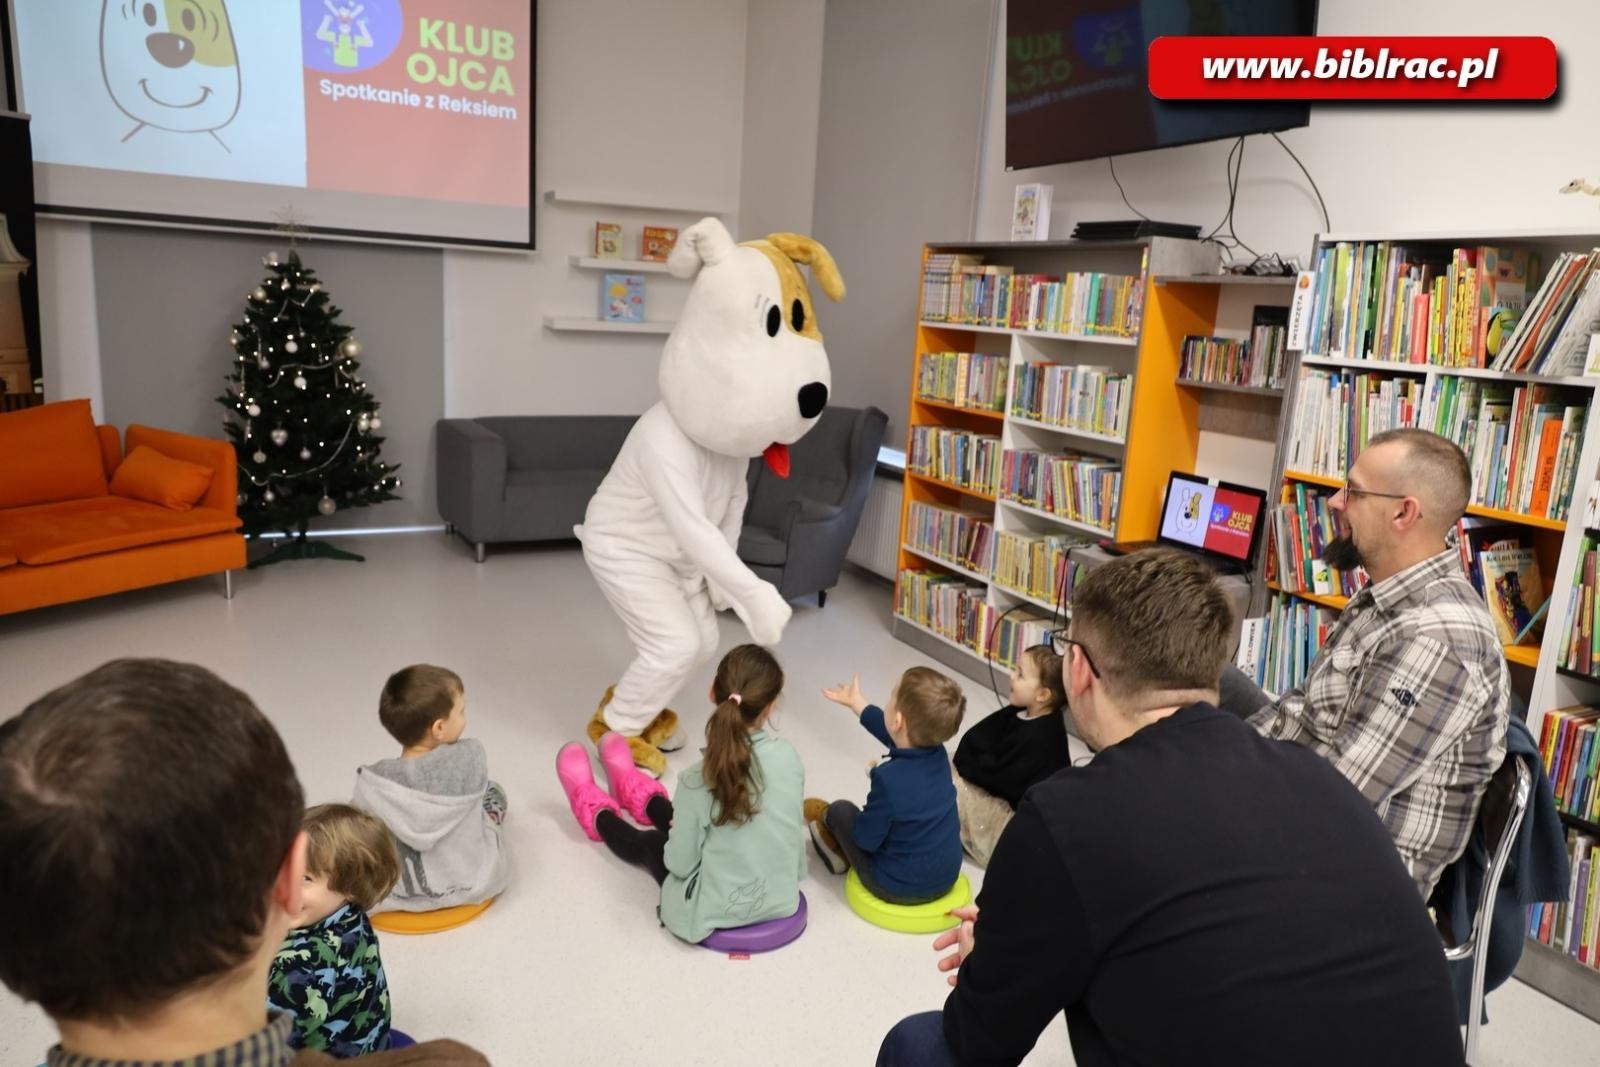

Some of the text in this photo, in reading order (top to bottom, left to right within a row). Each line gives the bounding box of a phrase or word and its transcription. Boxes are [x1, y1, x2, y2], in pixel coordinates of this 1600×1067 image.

[419, 17, 515, 61] KLUB
[406, 52, 515, 96] OJCA
[319, 79, 518, 120] Spotkanie z Reksiem
[1227, 519, 1250, 532] OJCA
[1232, 511, 1252, 523] KLUB
